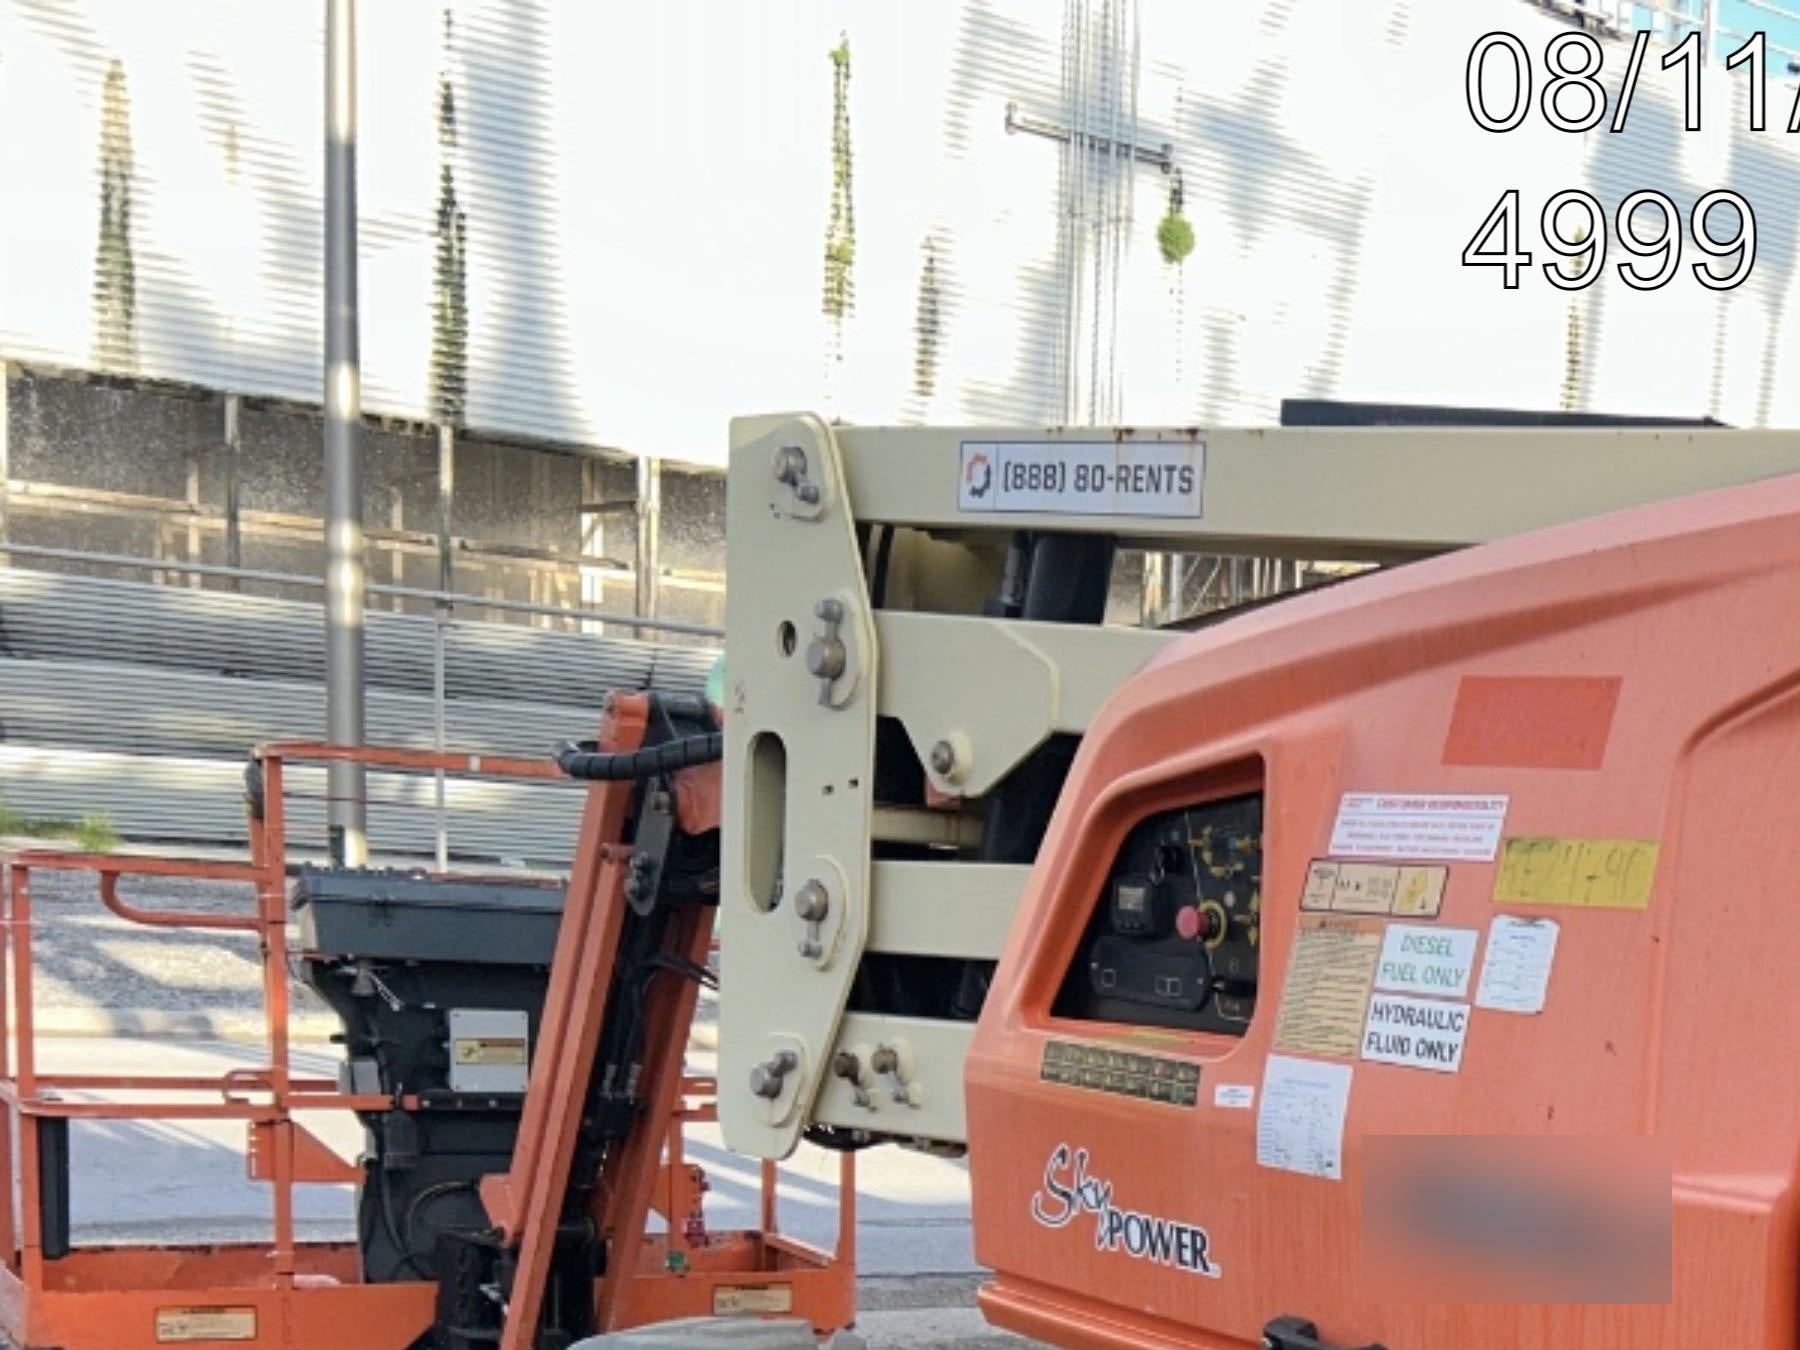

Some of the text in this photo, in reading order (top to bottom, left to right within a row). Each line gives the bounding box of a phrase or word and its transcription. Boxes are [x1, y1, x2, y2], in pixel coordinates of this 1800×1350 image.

[1003, 460, 1195, 496] (888) 80-RENTS
[1401, 932, 1455, 958] DIESEL
[1381, 962, 1465, 988] FUEL ONLY
[1372, 1002, 1464, 1033] HYDRAULIC
[1366, 1031, 1459, 1063] FLUID ONLY
[1033, 1144, 1211, 1273] Sky POWER
